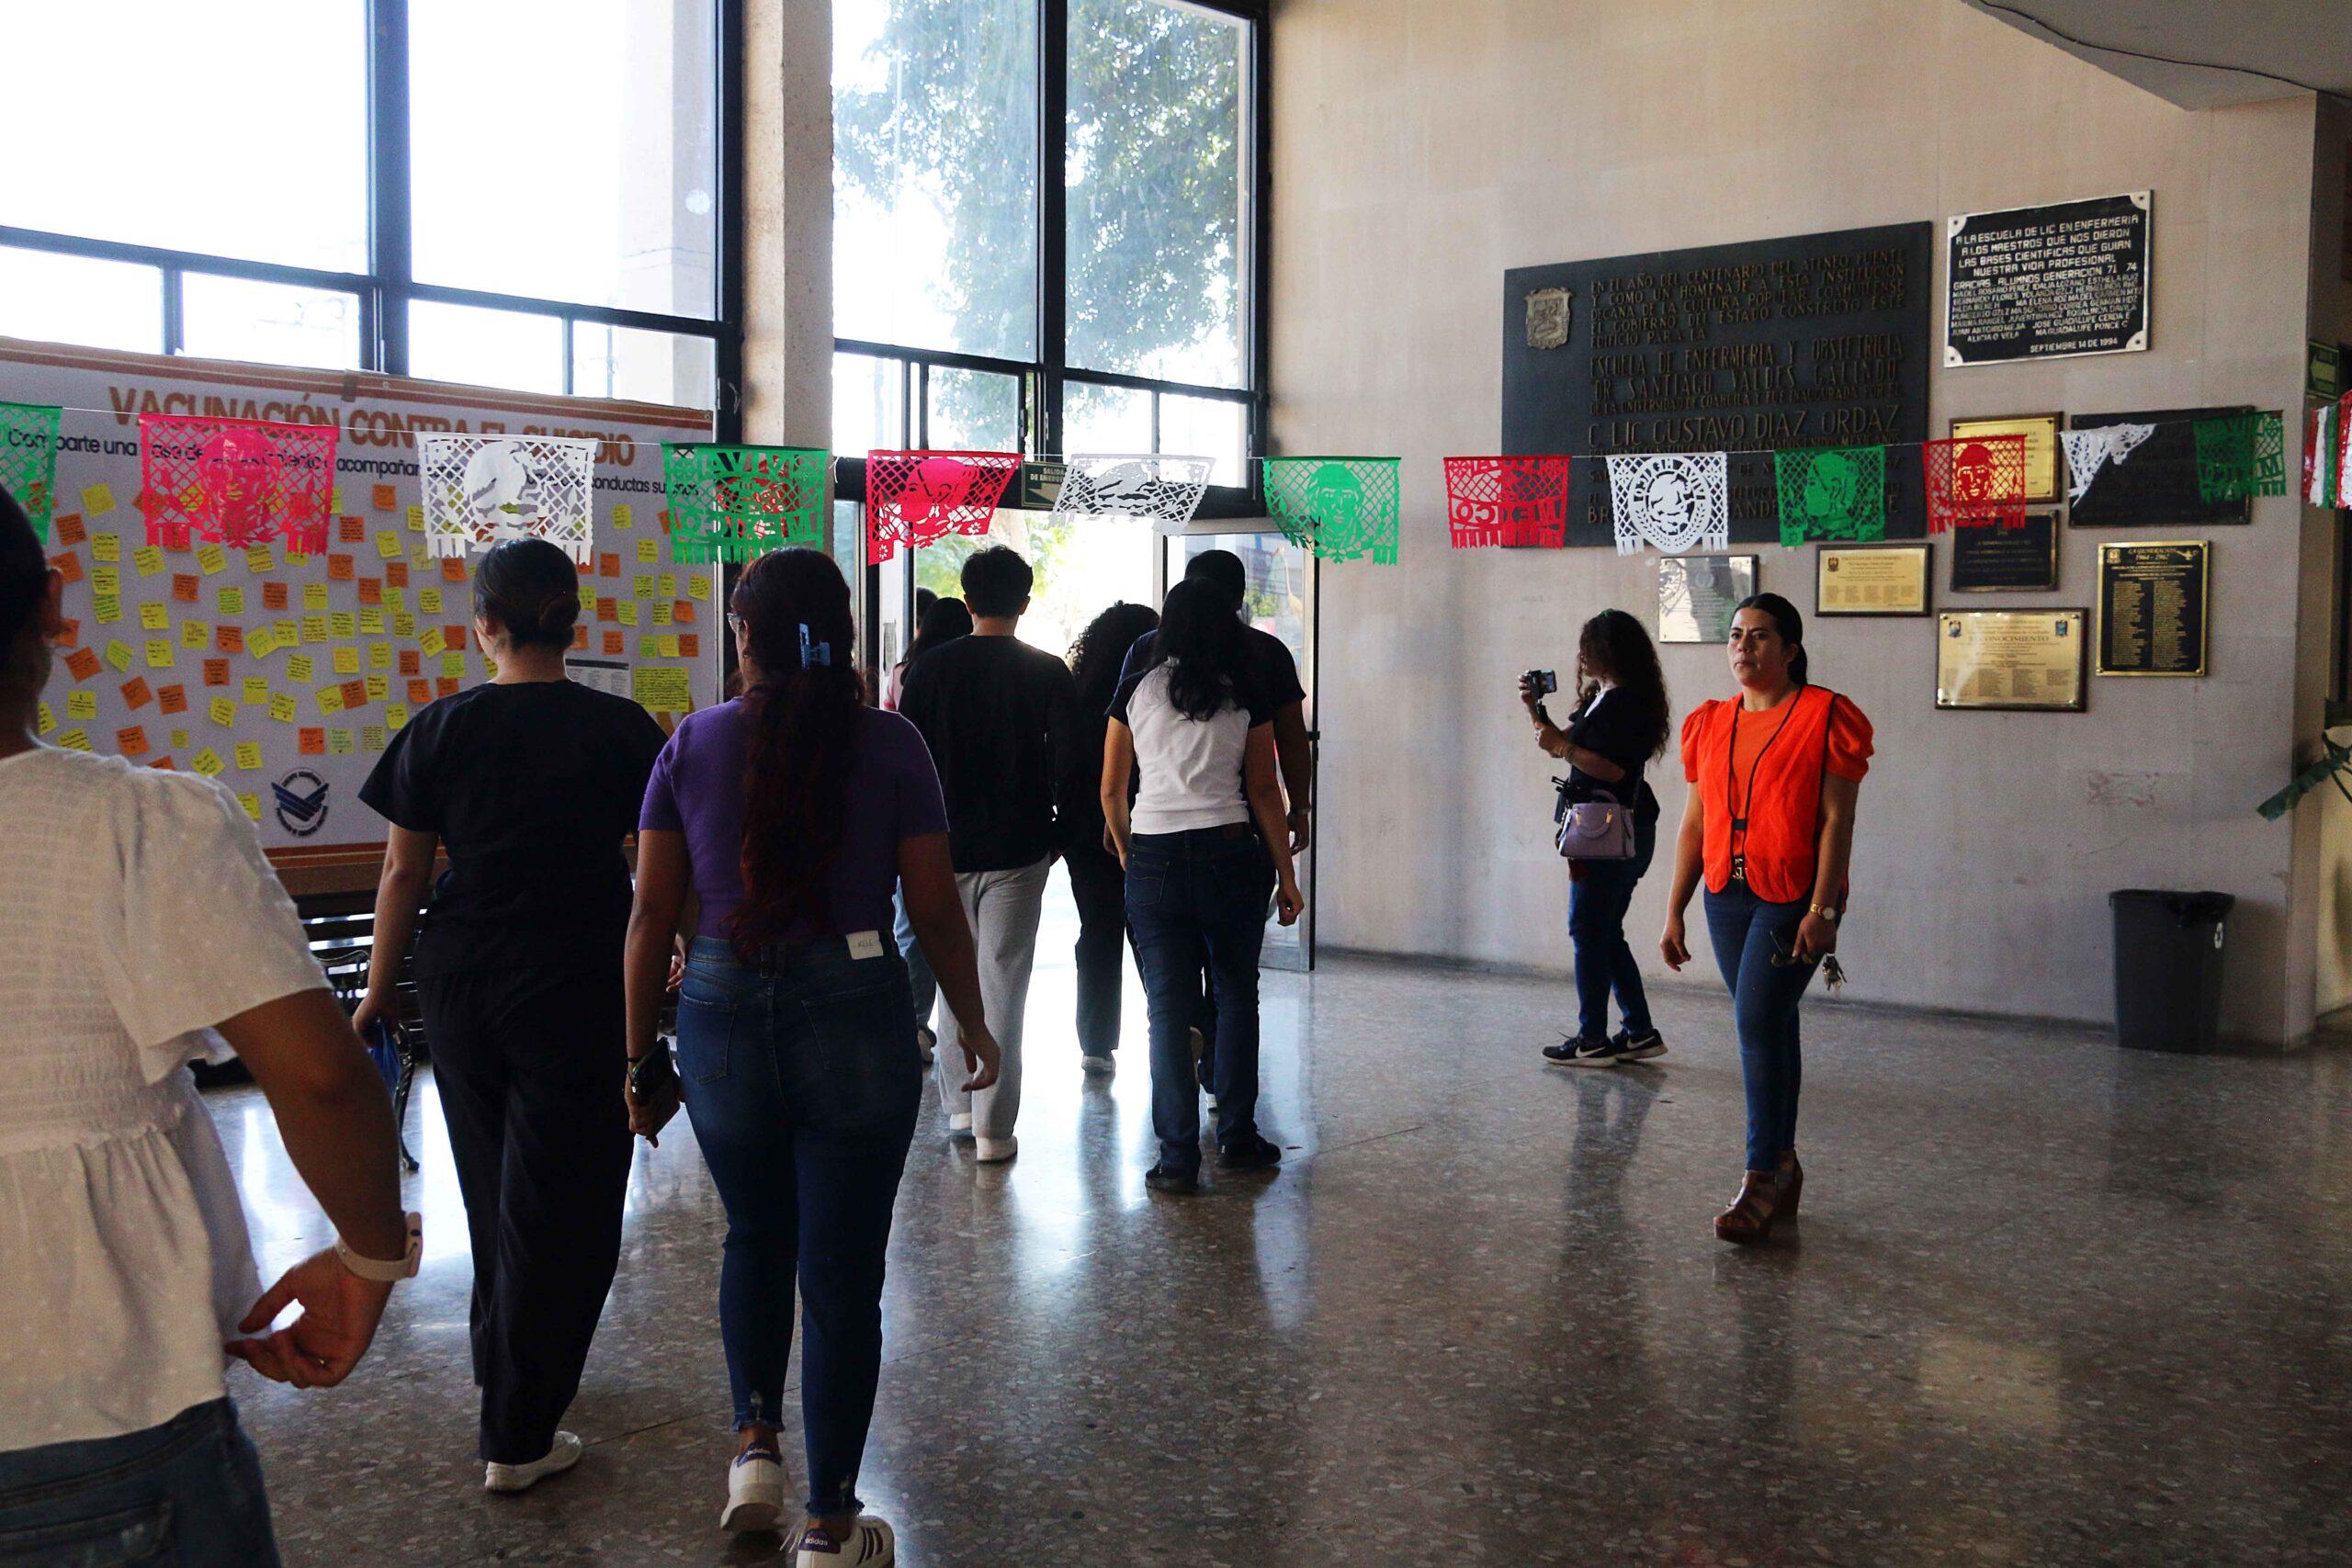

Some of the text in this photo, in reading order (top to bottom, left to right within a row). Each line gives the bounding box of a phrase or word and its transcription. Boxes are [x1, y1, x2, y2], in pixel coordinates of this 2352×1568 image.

[1956, 214, 2139, 245] A LA ESCUELA DE LIC EN ENFERMERIA
[1962, 228, 2130, 256] A LOS MAESTROS QUE NOS DIERON
[1959, 239, 2132, 268] LAS BASES CIENTIFICAS QUE GUIAN
[1973, 254, 2116, 276] NUESTRA VIDA PROFESIONAL
[1610, 291, 1644, 305] COMO
[1654, 288, 1670, 301] UN
[1680, 279, 1750, 299] HOMENAJE
[1759, 279, 1769, 290] A
[1780, 274, 1809, 288] ESTA
[1823, 264, 1905, 284] INSTITUCION
[1627, 272, 1653, 289] AÑO
[1660, 273, 1679, 287] DEL
[1686, 264, 1764, 284] CENTENARIO
[1771, 260, 1791, 275] DEL
[1801, 254, 1849, 272] ATENEO
[1997, 274, 2041, 286] ALUMNOS
[2042, 266, 2102, 282] GENERACION
[2126, 262, 2137, 272] 74
[1591, 307, 1634, 321] DECANA
[1643, 303, 1655, 316] DE
[1662, 301, 1676, 314] LA
[1683, 296, 1739, 312] CULTURA
[1747, 288, 1808, 306] POPULAR
[1591, 321, 1602, 336] EL
[1613, 317, 1676, 333] GOBIERNO
[1688, 313, 1707, 327] DEL
[1719, 308, 1770, 324] ESTADO
[1780, 299, 1860, 318] CONSTRUYO
[1590, 328, 1706, 348] EDIFICIO PARA LA
[2030, 341, 2076, 353] SEPTIEMBRE
[2087, 339, 2098, 347] DE
[2100, 337, 2118, 346] 1994
[1589, 353, 1645, 378] ESCUELA
[1658, 352, 1672, 374] DE
[1685, 343, 1774, 371] ENFERMERIA
[1811, 334, 1904, 361] OBSTETRICIA
[1628, 373, 1713, 399] SANTIAGO
[1731, 366, 1794, 392] VALDES
[1814, 358, 1897, 387] GALINDO
[1611, 421, 1643, 446] LIC
[1653, 414, 1745, 445] GUSTAVO
[1755, 411, 1808, 439] DIAZ
[1821, 404, 1900, 434] ORDAZ
[104, 438, 138, 457] una
